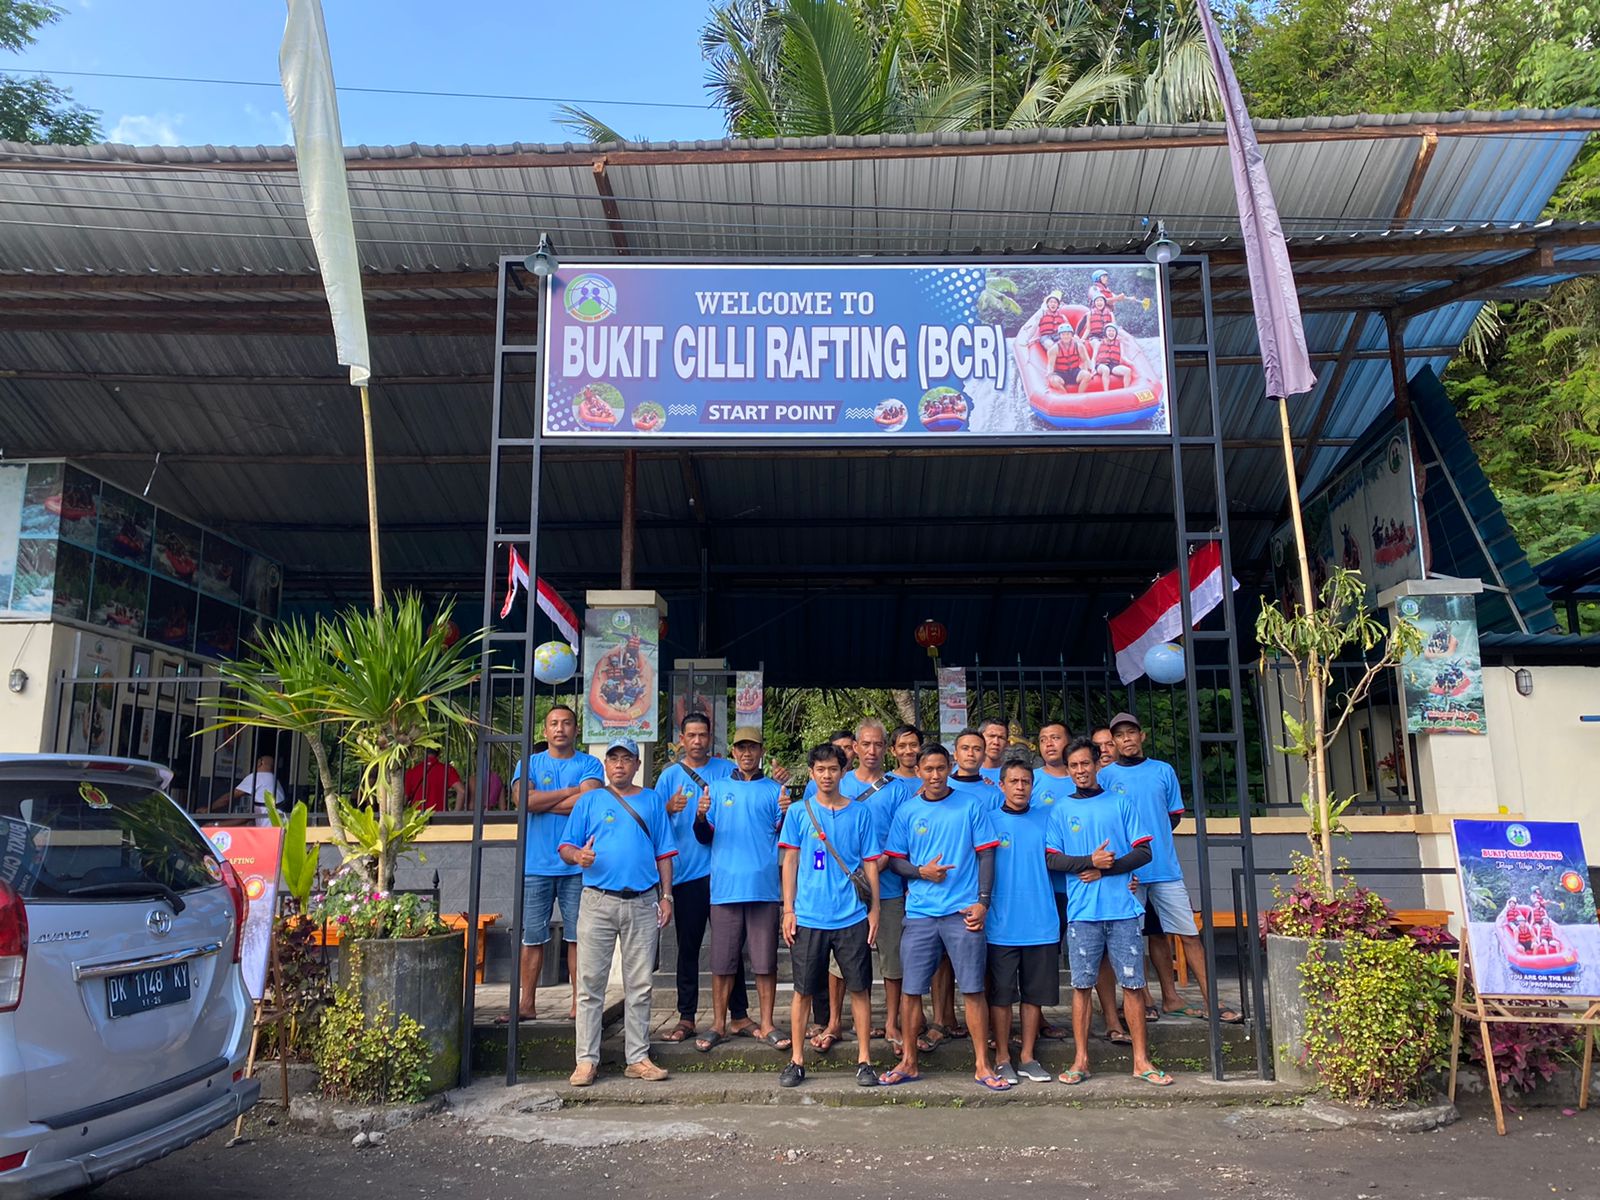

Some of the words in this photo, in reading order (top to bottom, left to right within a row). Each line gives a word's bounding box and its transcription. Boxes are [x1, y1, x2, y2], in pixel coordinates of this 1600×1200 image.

[695, 292, 832, 315] WELCOME
[840, 292, 873, 315] TO
[562, 325, 664, 379] BUKIT
[673, 325, 755, 379] CILLI
[766, 325, 907, 379] RAFTING
[918, 324, 1006, 390] (BCR)
[708, 405, 769, 420] START
[775, 405, 836, 420] POINT
[227, 856, 256, 865] AFTING
[1482, 849, 1506, 858] BUKIT
[110, 976, 127, 1003] DK
[135, 970, 163, 998] 1148
[173, 964, 188, 988] KY
